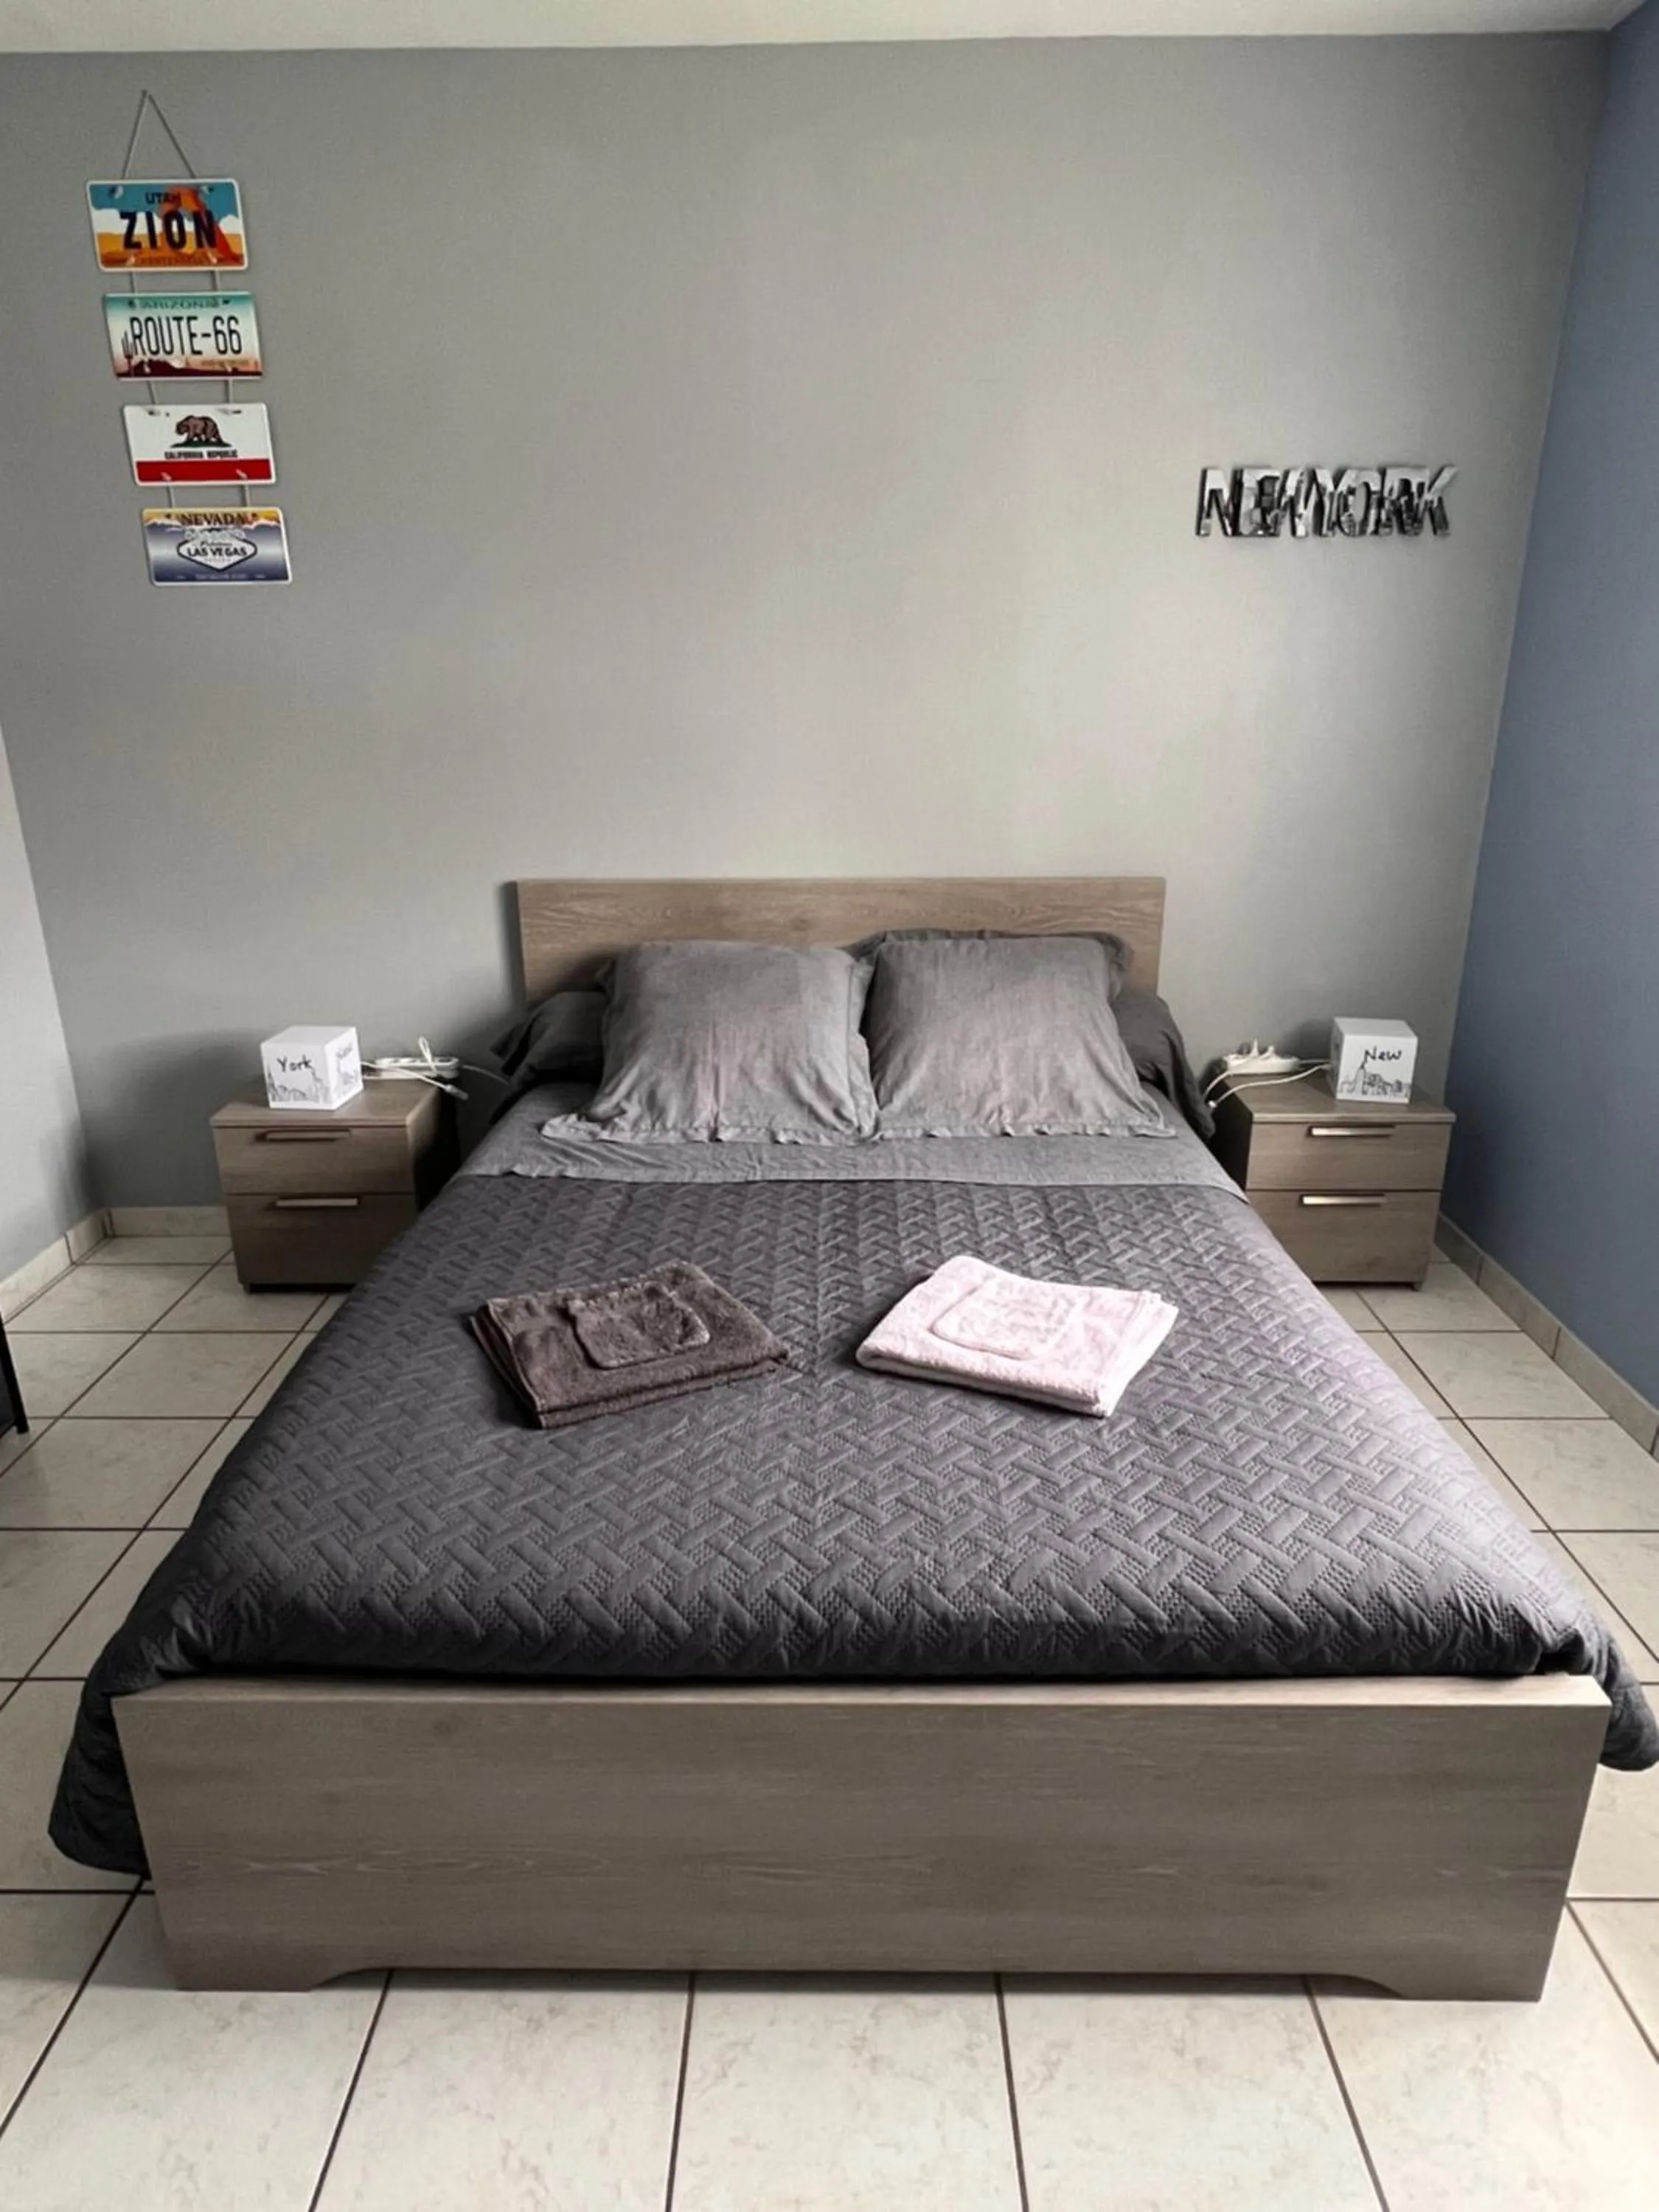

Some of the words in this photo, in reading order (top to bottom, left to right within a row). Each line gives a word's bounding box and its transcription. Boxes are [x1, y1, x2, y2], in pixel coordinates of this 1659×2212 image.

[119, 209, 217, 249] ZION
[130, 316, 242, 355] ROUTE-66
[179, 512, 248, 526] NEVADA
[187, 548, 207, 557] LAS
[209, 547, 248, 556] VEGAS
[1364, 1046, 1402, 1061] New
[276, 1054, 311, 1073] York
